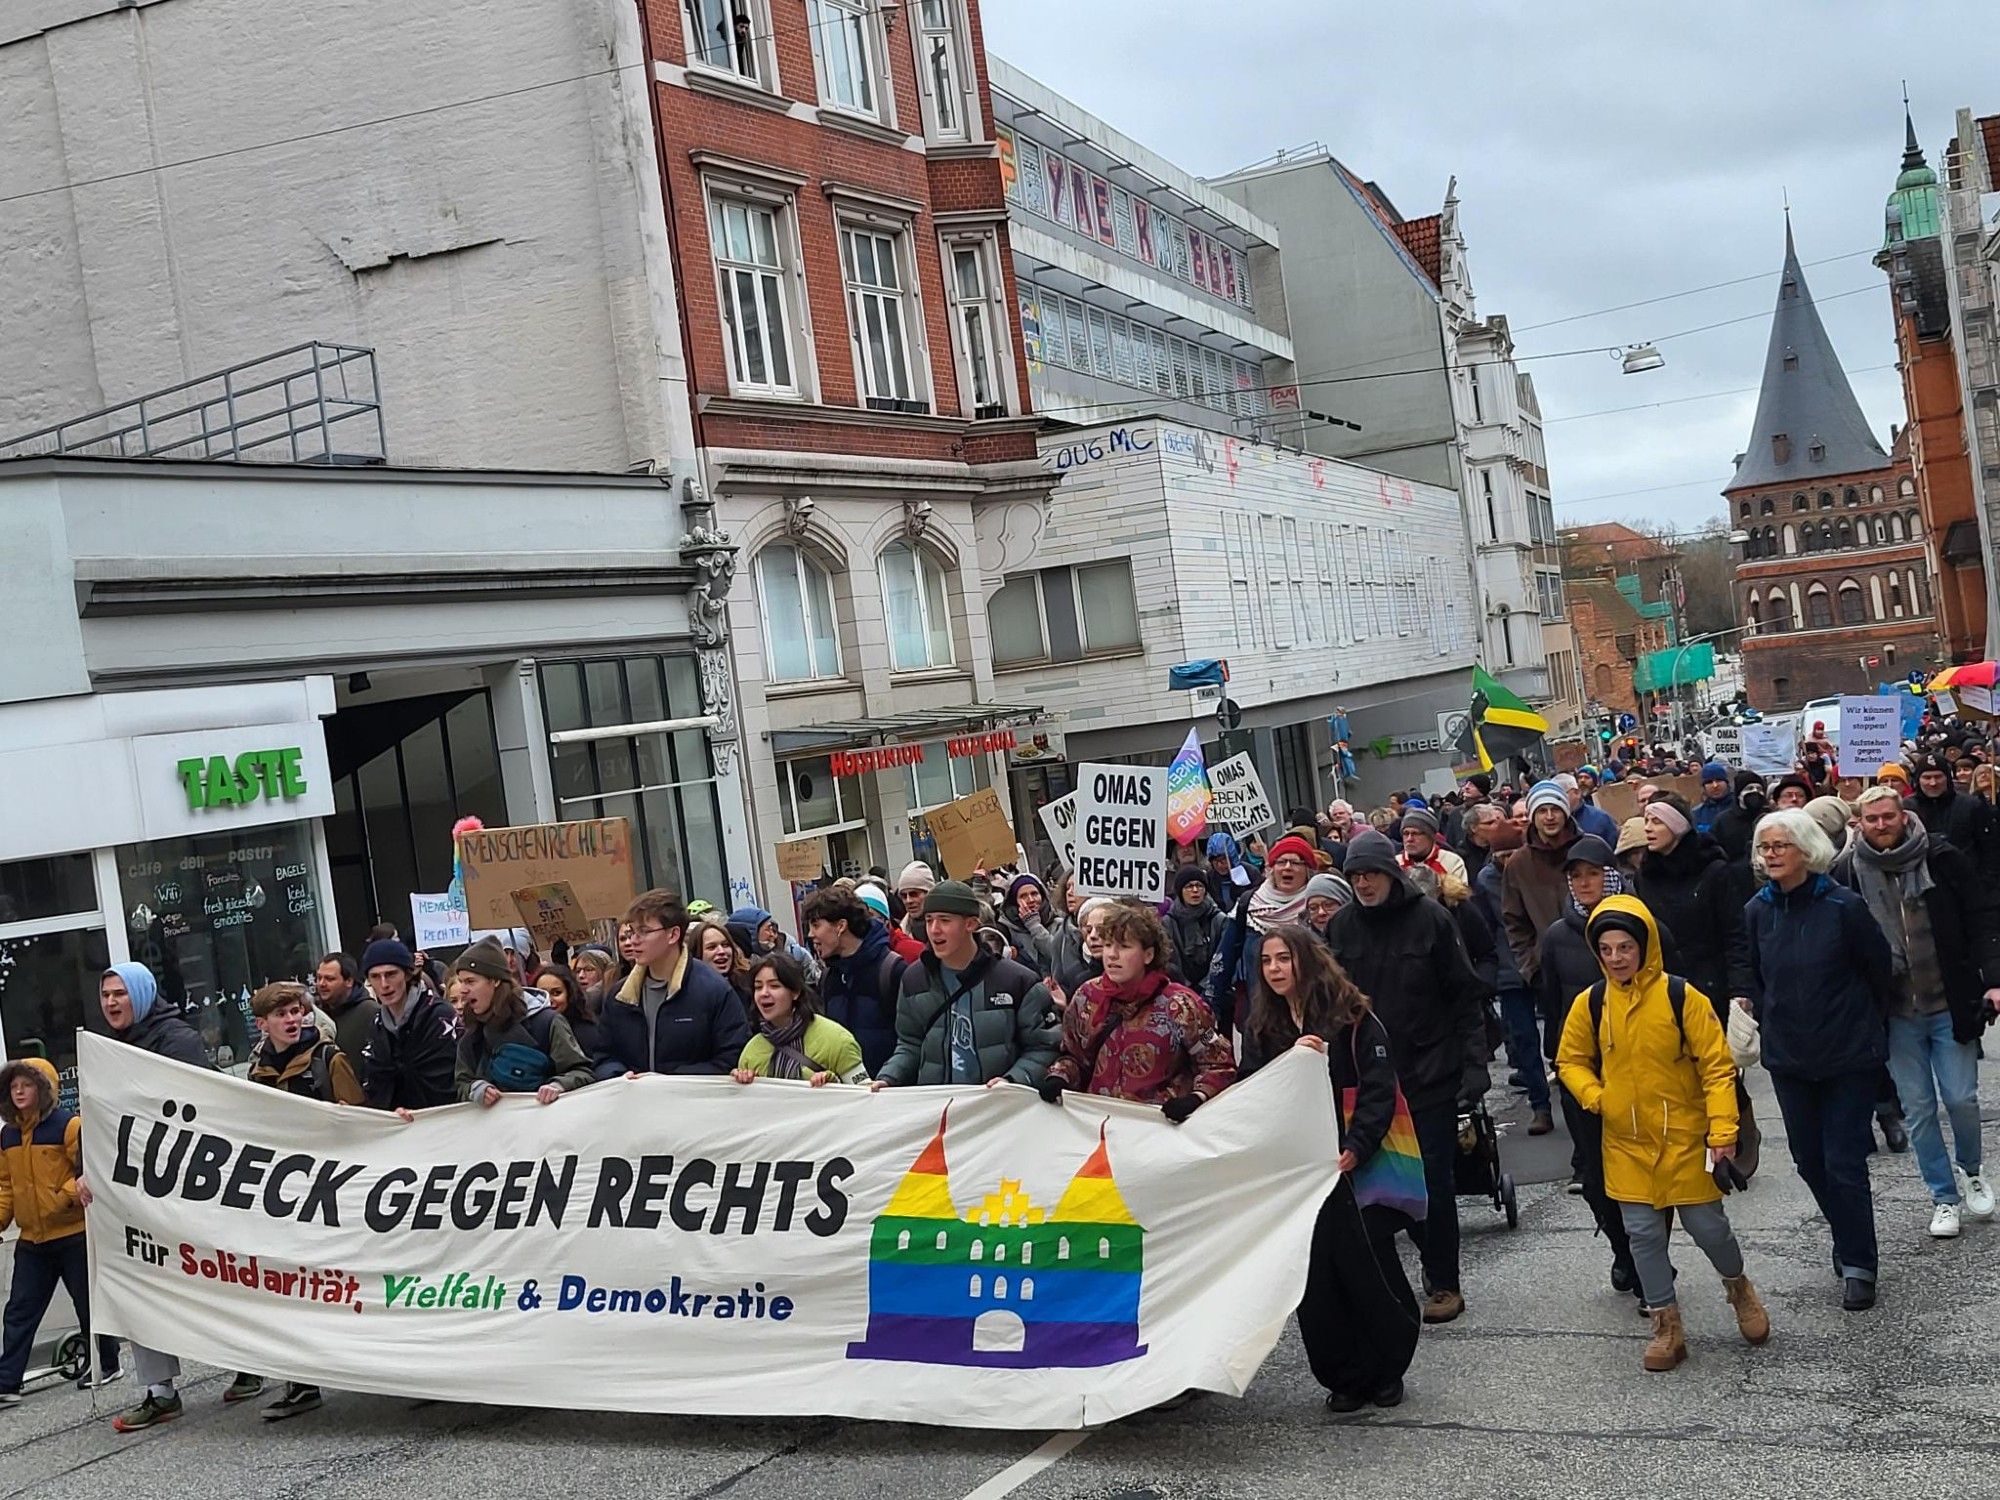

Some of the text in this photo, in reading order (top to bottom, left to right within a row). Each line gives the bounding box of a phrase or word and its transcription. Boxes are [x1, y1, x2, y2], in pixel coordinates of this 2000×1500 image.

[1846, 706, 1894, 714] Wir können
[1717, 730, 1737, 739] OMAS
[1853, 723, 1887, 731] stoppen!
[1400, 738, 1439, 752] free
[1715, 743, 1740, 753] GEGEN
[178, 747, 307, 808] TASTE
[1216, 761, 1245, 786] OMAS
[1093, 773, 1151, 806] OMAS
[1086, 815, 1155, 848] GEGEN
[228, 846, 273, 863] pastry
[275, 863, 306, 881] BAGELS
[1079, 856, 1160, 892] RECHTS
[203, 897, 222, 915] fresh
[423, 927, 463, 942] RECHTE
[112, 1099, 855, 1237] LÜBECK GEGEN RECHTS
[124, 1225, 794, 1321] Für Solidarität, Vielfalt & Demokratie
